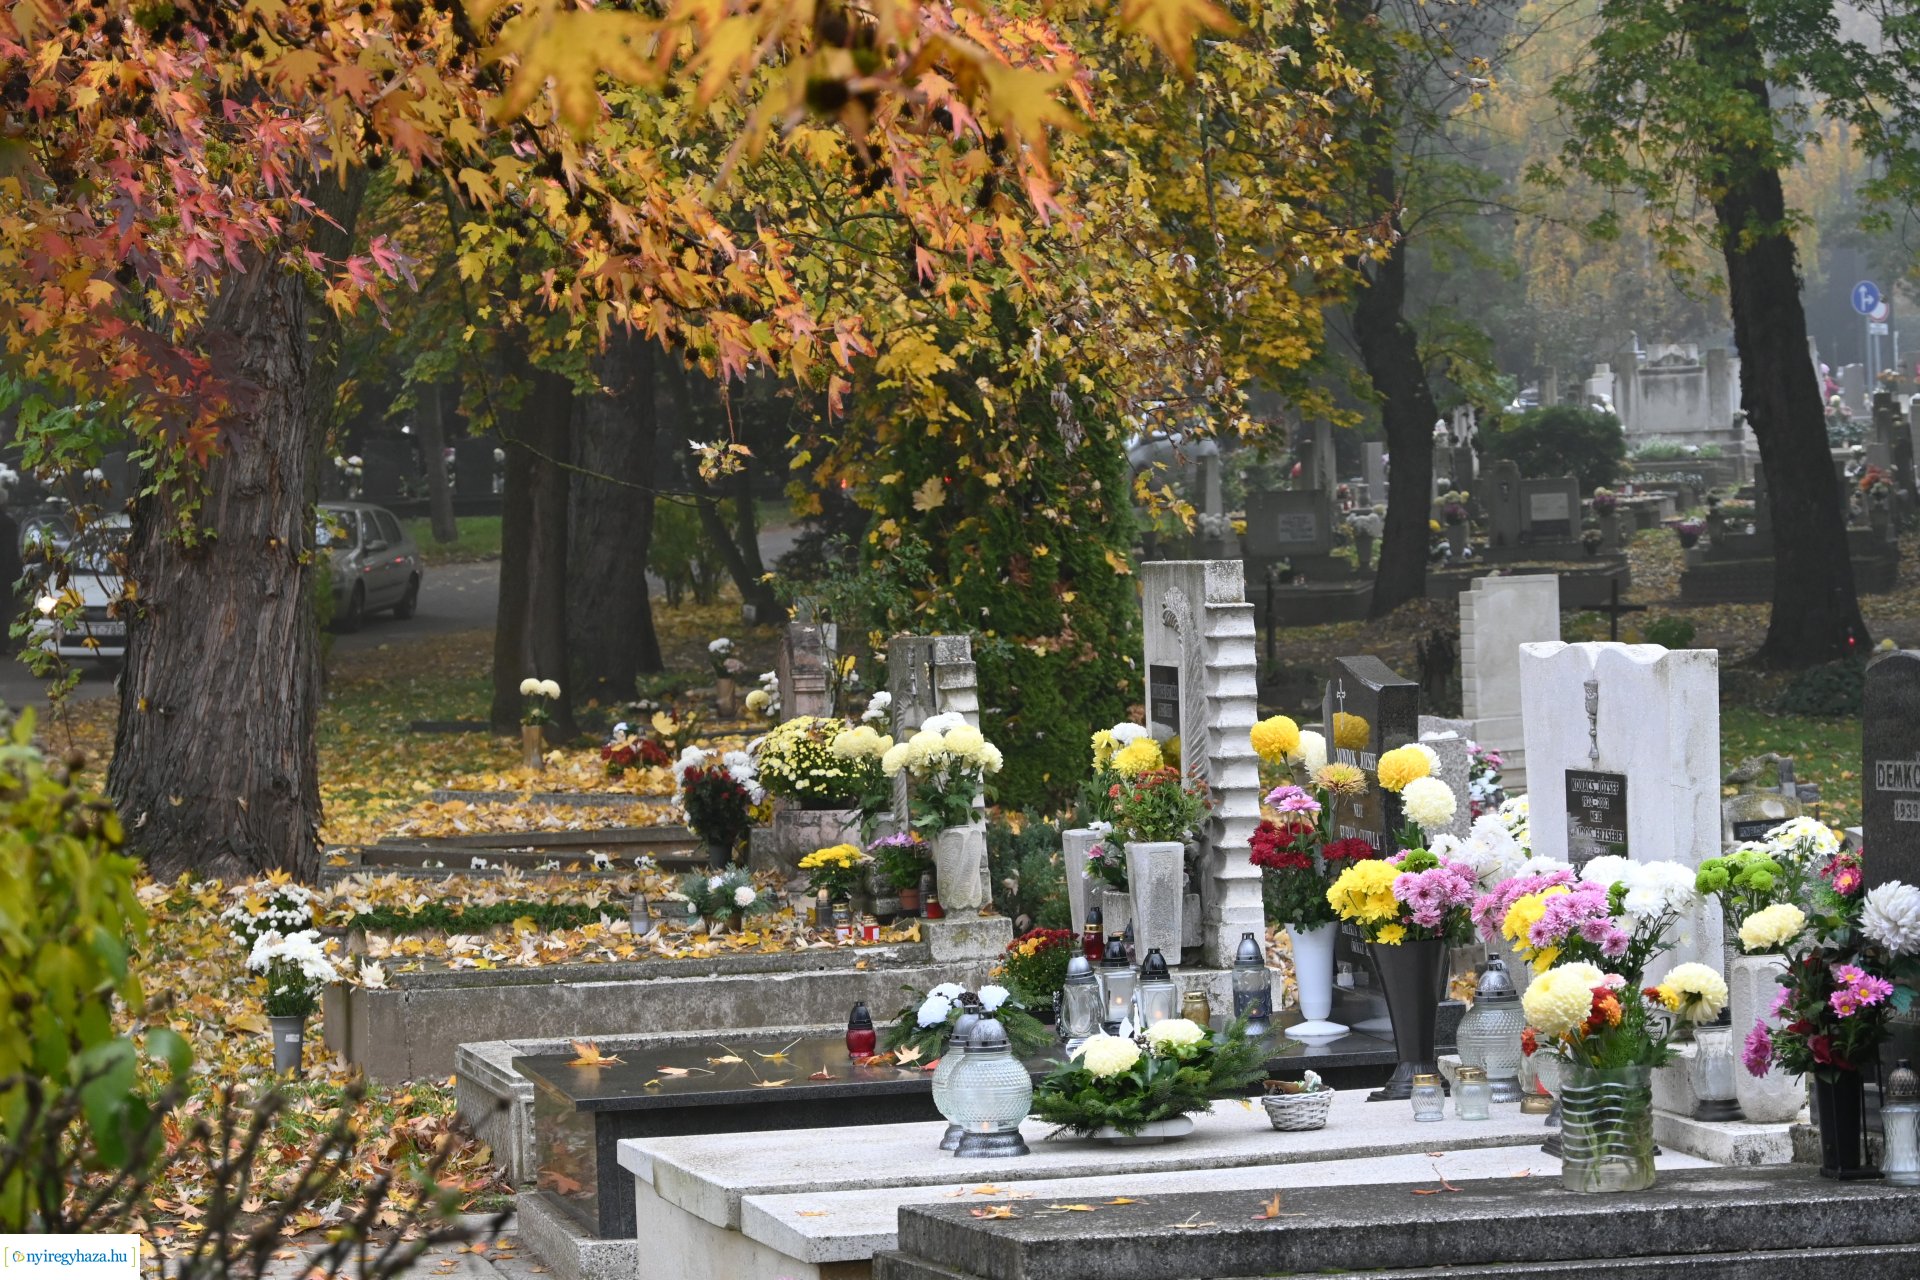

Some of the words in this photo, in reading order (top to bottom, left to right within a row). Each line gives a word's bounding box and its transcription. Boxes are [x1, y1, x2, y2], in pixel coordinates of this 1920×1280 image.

[1571, 775, 1595, 793] KOVÁCS
[1597, 776, 1619, 795] JÓZSEF
[1595, 825, 1624, 843] ERZSÉBET
